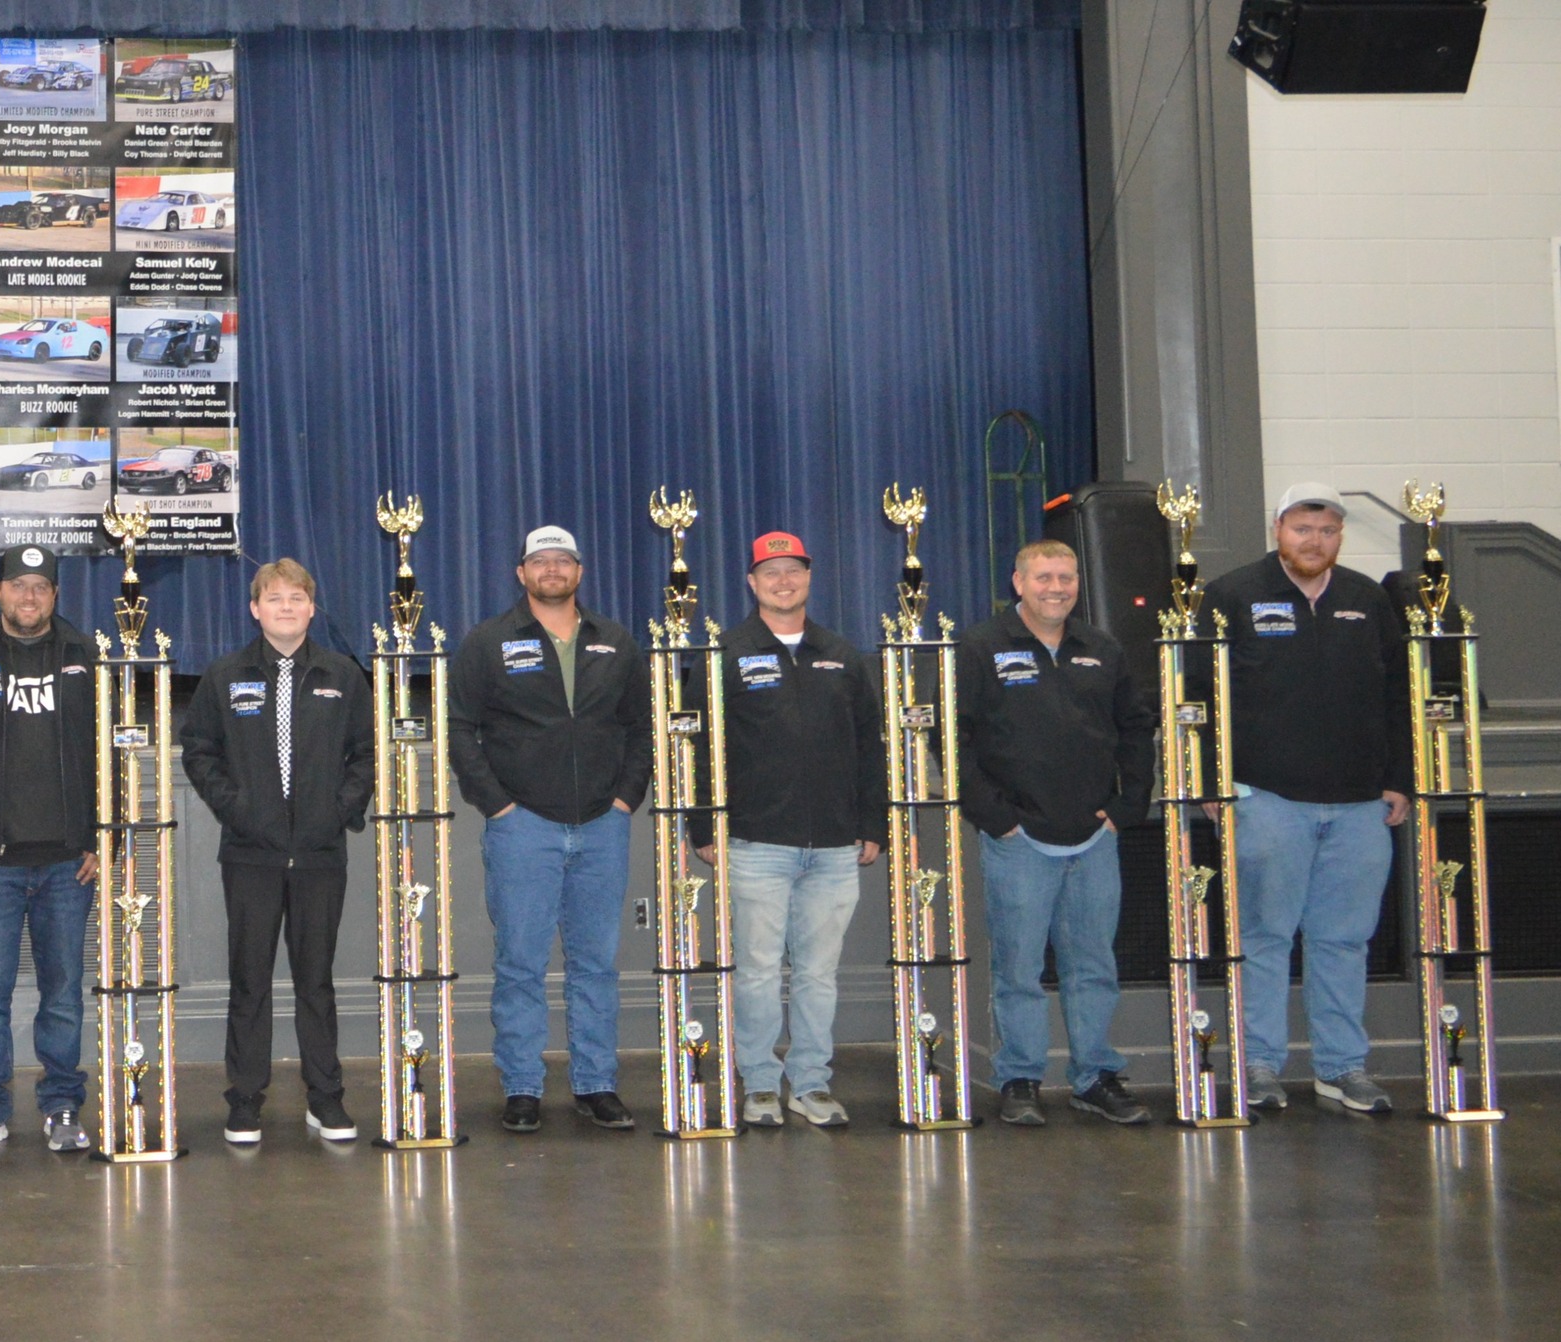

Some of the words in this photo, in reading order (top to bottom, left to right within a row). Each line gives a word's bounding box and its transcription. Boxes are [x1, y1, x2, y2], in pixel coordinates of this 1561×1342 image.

[191, 75, 210, 92] 24
[26, 106, 58, 116] MODIFIED
[60, 107, 95, 116] CHAMPION
[136, 108, 153, 118] PURE
[155, 108, 179, 118] STREET
[180, 108, 215, 118] CHAMPION
[3, 123, 36, 137] Joey
[38, 123, 88, 137] Morgan
[135, 124, 167, 136] Nate
[169, 125, 213, 136] Carter
[124, 139, 147, 147] Daniel
[147, 139, 170, 147] Green
[174, 139, 194, 147] Chad
[194, 139, 223, 147] Bearden
[46, 256, 103, 268] Modecai
[135, 256, 183, 268] Samuel
[185, 257, 217, 271] Kelly
[7, 273, 26, 286] LATE
[27, 273, 55, 286] MODEL
[56, 273, 87, 286] ROOKIE
[129, 283, 150, 291] Eddie
[150, 283, 170, 291] Dodd
[175, 283, 198, 291] Chase
[198, 283, 223, 291] Owens
[60, 335, 74, 349] 12
[143, 369, 175, 379] MODIFIED
[177, 369, 212, 379] CHAMPION
[36, 383, 110, 397] Mooneyham
[137, 384, 178, 395] Jacob
[179, 384, 216, 397] Wyatt
[20, 401, 43, 413] BUZZ
[45, 400, 78, 414] ROOKIE
[127, 398, 152, 406] Robert
[184, 398, 204, 406] Brian
[204, 399, 226, 407] Green
[196, 463, 213, 483] 78
[158, 501, 176, 510] SHOT
[177, 501, 213, 510] CHAMPION
[0, 517, 47, 528] Tanner
[49, 516, 98, 528] Hudson
[170, 516, 222, 530] England
[4, 531, 33, 544] SUPER
[35, 531, 58, 544] BUZZ
[61, 531, 93, 544] ROOKIE
[150, 532, 167, 541] Gray
[172, 531, 196, 540] Brodie
[197, 531, 233, 541] Fitzgerald
[146, 543, 183, 551] Blackburn
[187, 543, 204, 551] Fred
